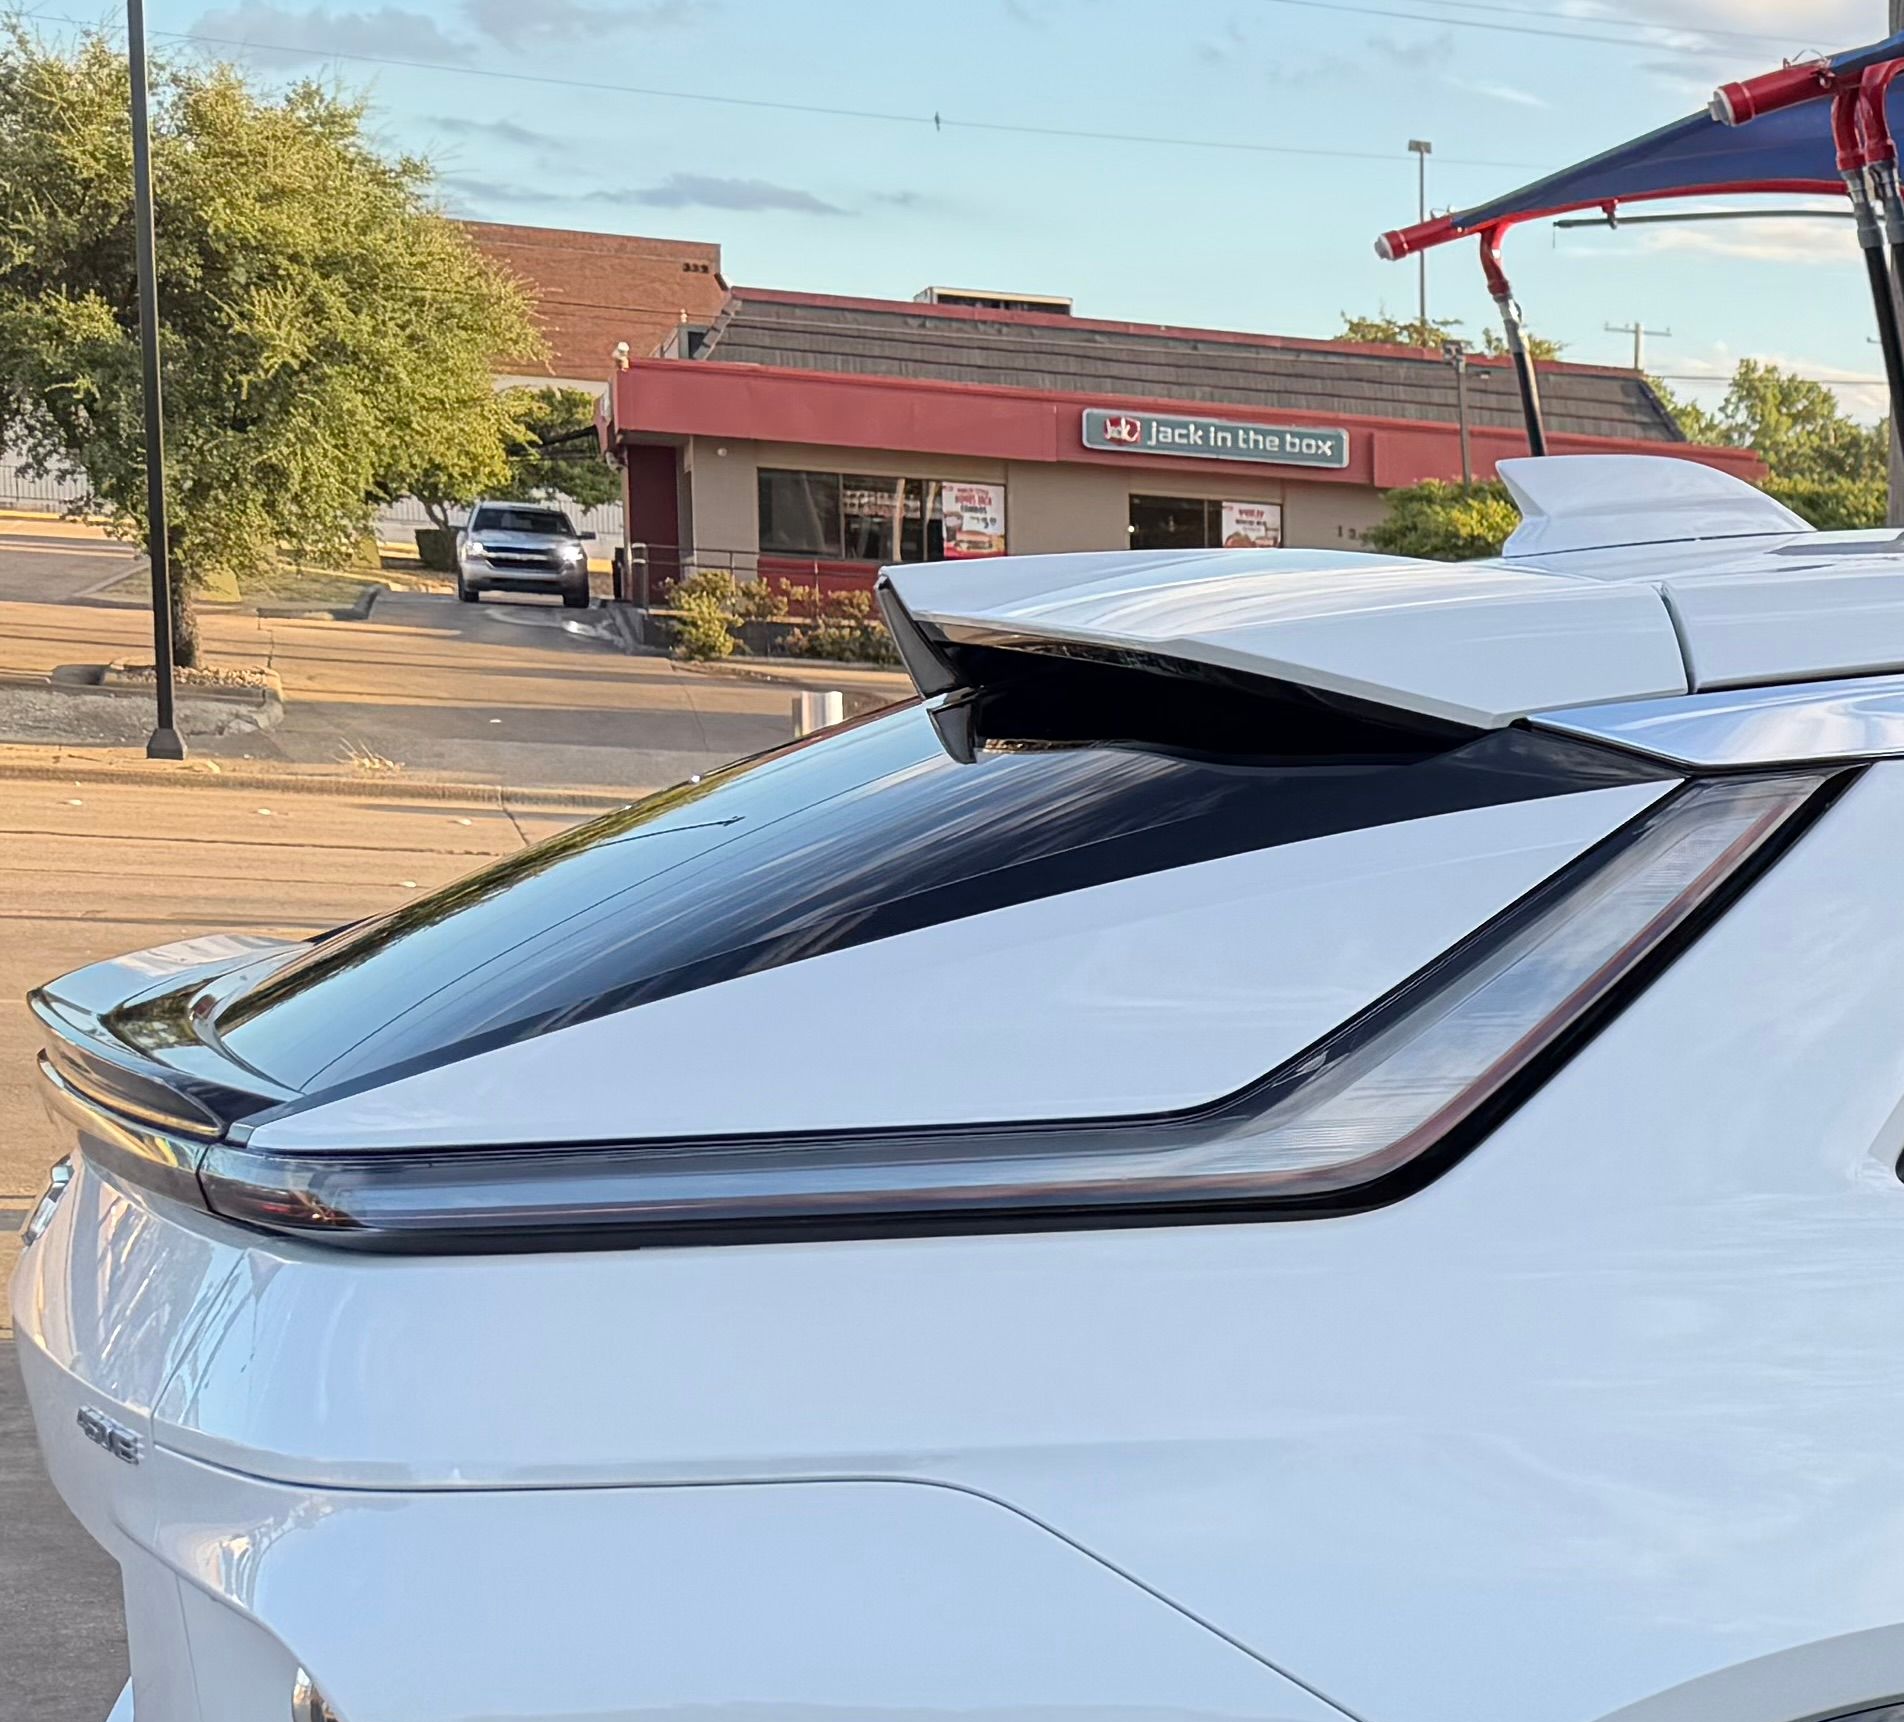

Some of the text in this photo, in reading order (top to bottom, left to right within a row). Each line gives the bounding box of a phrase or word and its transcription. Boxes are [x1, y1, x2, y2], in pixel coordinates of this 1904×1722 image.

[1147, 421, 1333, 457] jack in the box
